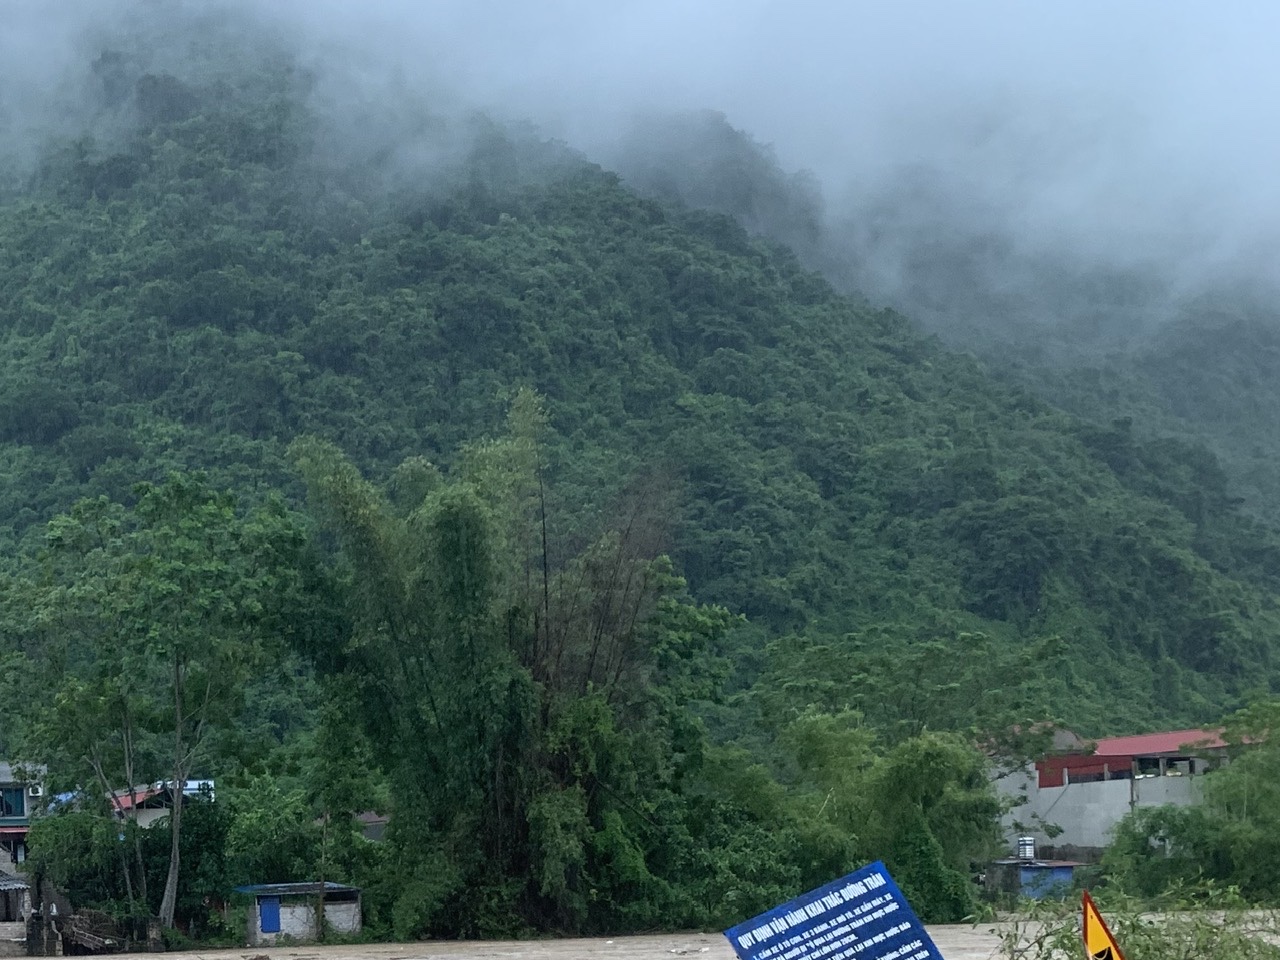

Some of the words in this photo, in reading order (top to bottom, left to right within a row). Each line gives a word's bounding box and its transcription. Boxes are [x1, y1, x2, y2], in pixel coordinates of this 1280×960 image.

[738, 932, 755, 949] QUY
[752, 924, 774, 942] ĐỊNH
[769, 917, 789, 934] VẬN
[785, 908, 809, 926] HÀNH
[804, 900, 826, 918] KHAI
[821, 892, 843, 910] THÁC
[840, 881, 867, 901] ĐƯỜNG
[863, 873, 886, 890] TRÀN
[813, 937, 826, 946] QUA
[824, 932, 834, 941] LẠI
[849, 919, 865, 929] TRÀN
[910, 940, 922, 949] CÁC
[758, 949, 772, 959] CẤM
[844, 947, 856, 957] QUA
